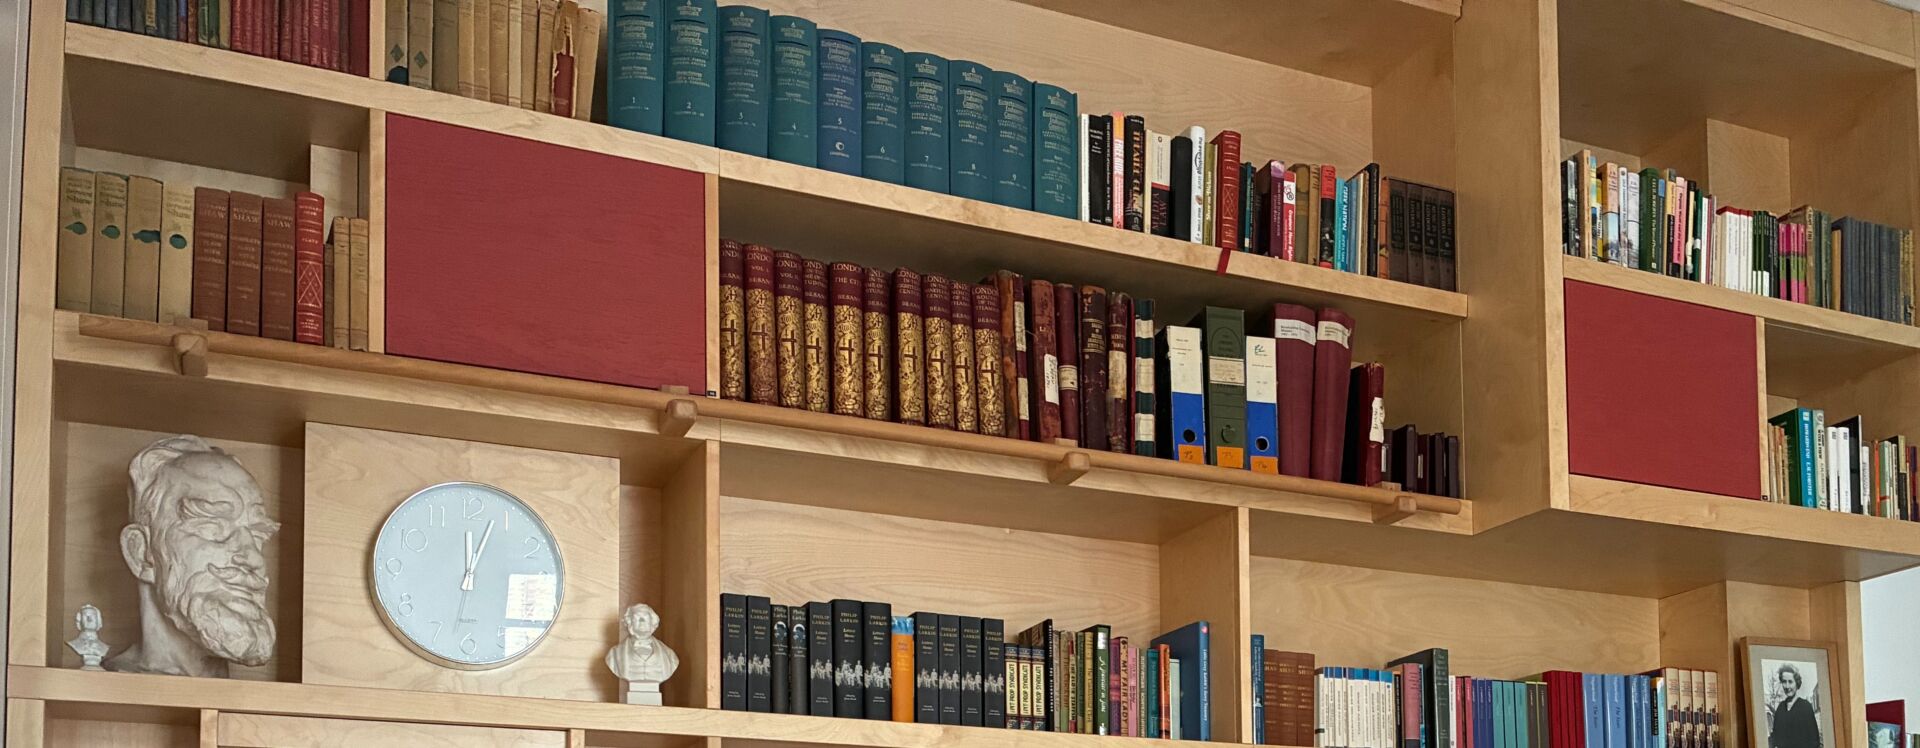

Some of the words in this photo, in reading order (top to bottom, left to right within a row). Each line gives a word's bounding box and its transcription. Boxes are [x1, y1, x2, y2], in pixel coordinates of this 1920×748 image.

[429, 504, 445, 528] 11
[462, 497, 484, 521] 12
[401, 528, 429, 552] 10
[523, 536, 541, 560] 2
[386, 557, 403, 581] 9
[398, 593, 413, 617] 8
[427, 621, 444, 643] 7
[460, 632, 476, 655] 6
[1121, 660, 1127, 673] MY
